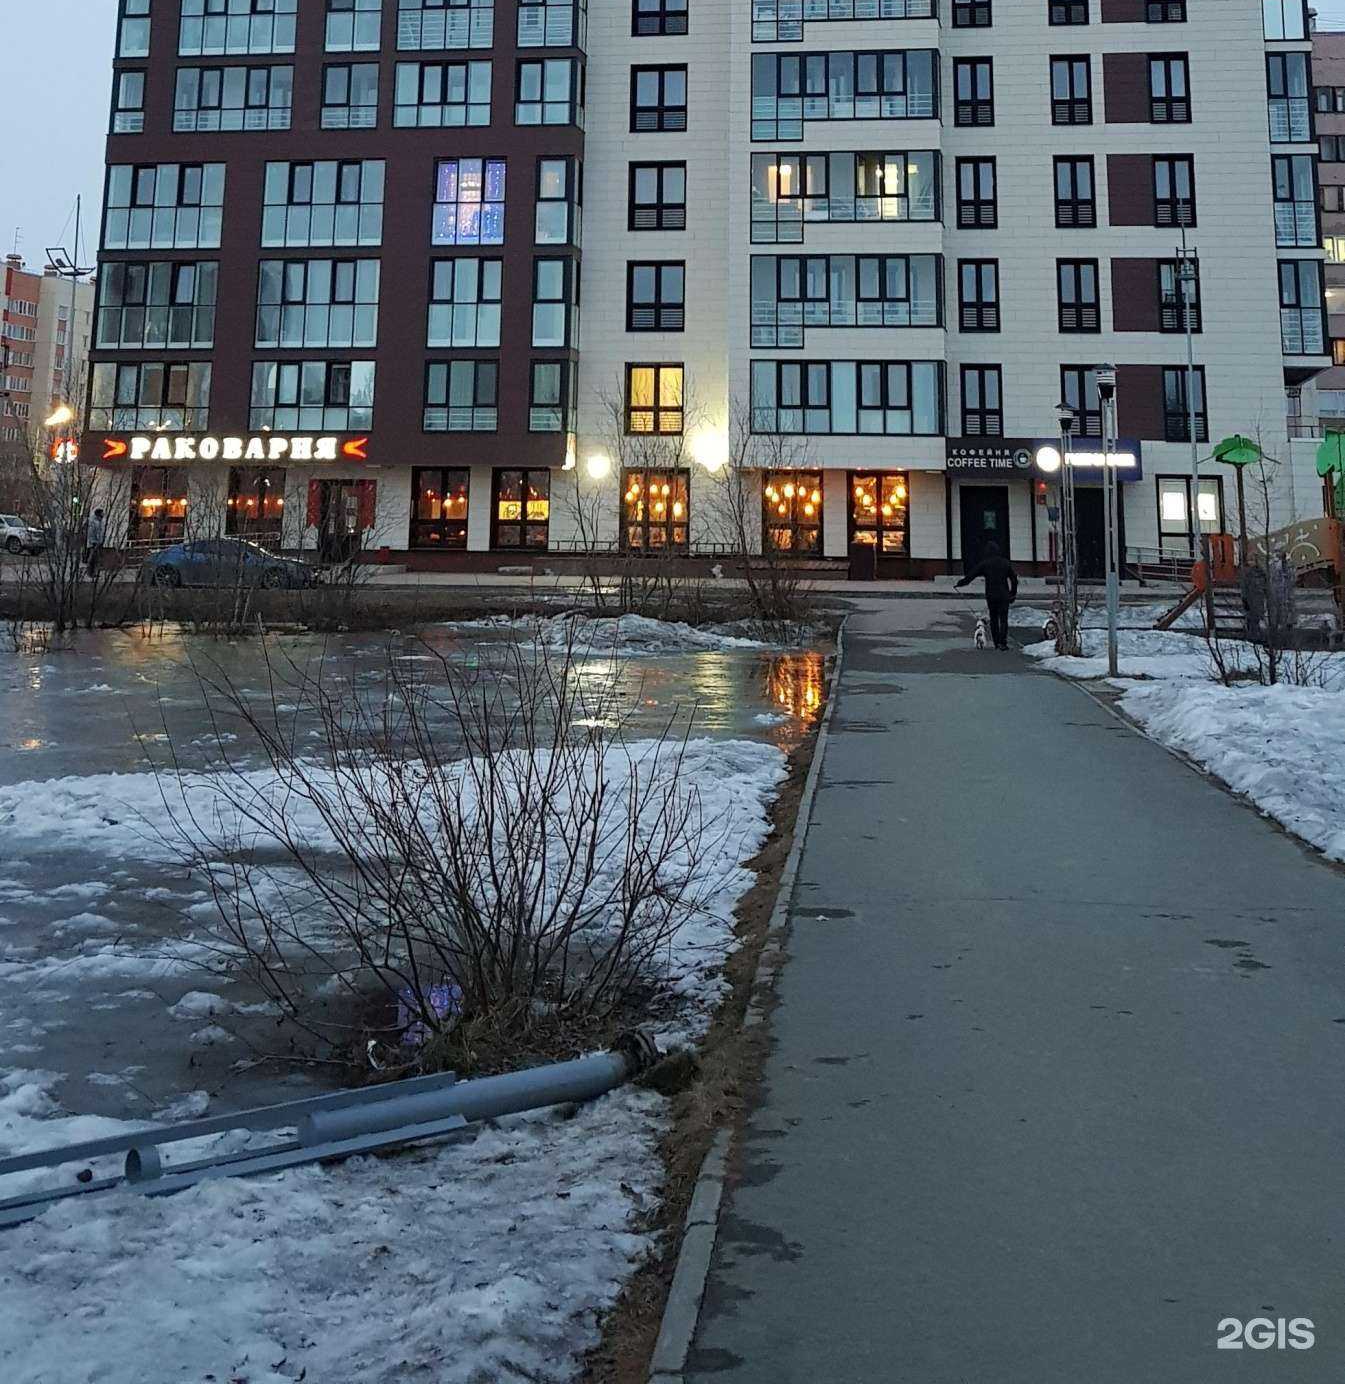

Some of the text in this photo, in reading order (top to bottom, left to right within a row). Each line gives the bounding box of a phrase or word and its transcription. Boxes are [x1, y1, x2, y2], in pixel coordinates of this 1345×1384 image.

[130, 437, 337, 460] РАКОВАРНЯ
[952, 448, 1011, 456] КОФЕЙНЯ
[947, 458, 1013, 468] COFFEE TIME
